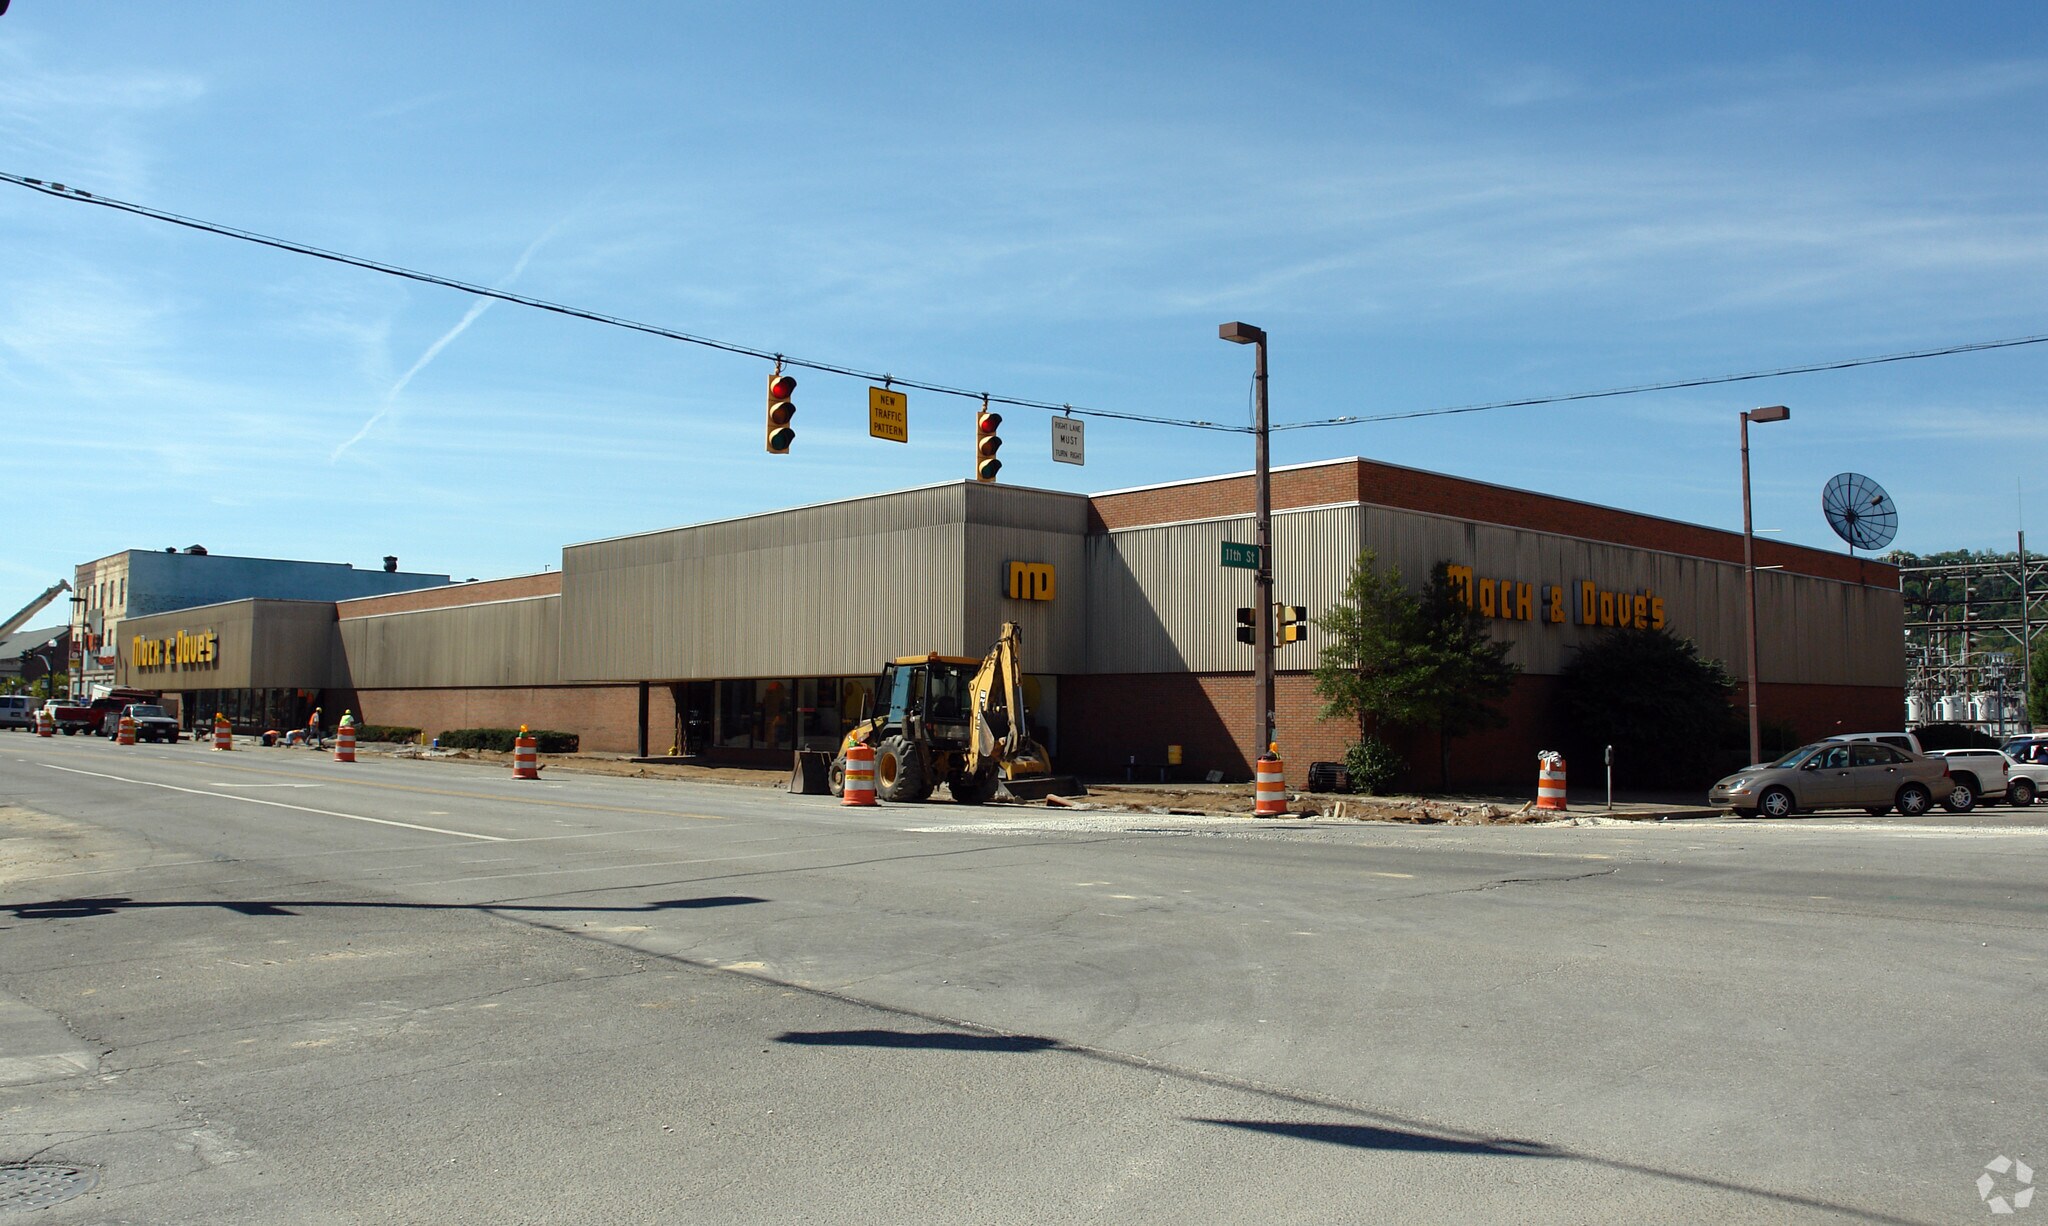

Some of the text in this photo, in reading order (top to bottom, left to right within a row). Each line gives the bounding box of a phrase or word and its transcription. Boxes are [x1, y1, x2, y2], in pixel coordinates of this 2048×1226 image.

[880, 394, 896, 406] NEW
[874, 407, 902, 422] TRAFFIC
[873, 421, 903, 437] PATTERN
[1055, 421, 1081, 433] RIGHT LANE
[1060, 434, 1078, 445] MUST
[1055, 449, 1082, 460] TURN RIGHT
[1225, 548, 1255, 563] 11th St
[1447, 564, 1665, 631] Mack & Dave's
[132, 627, 215, 667] Mack & Dave's
